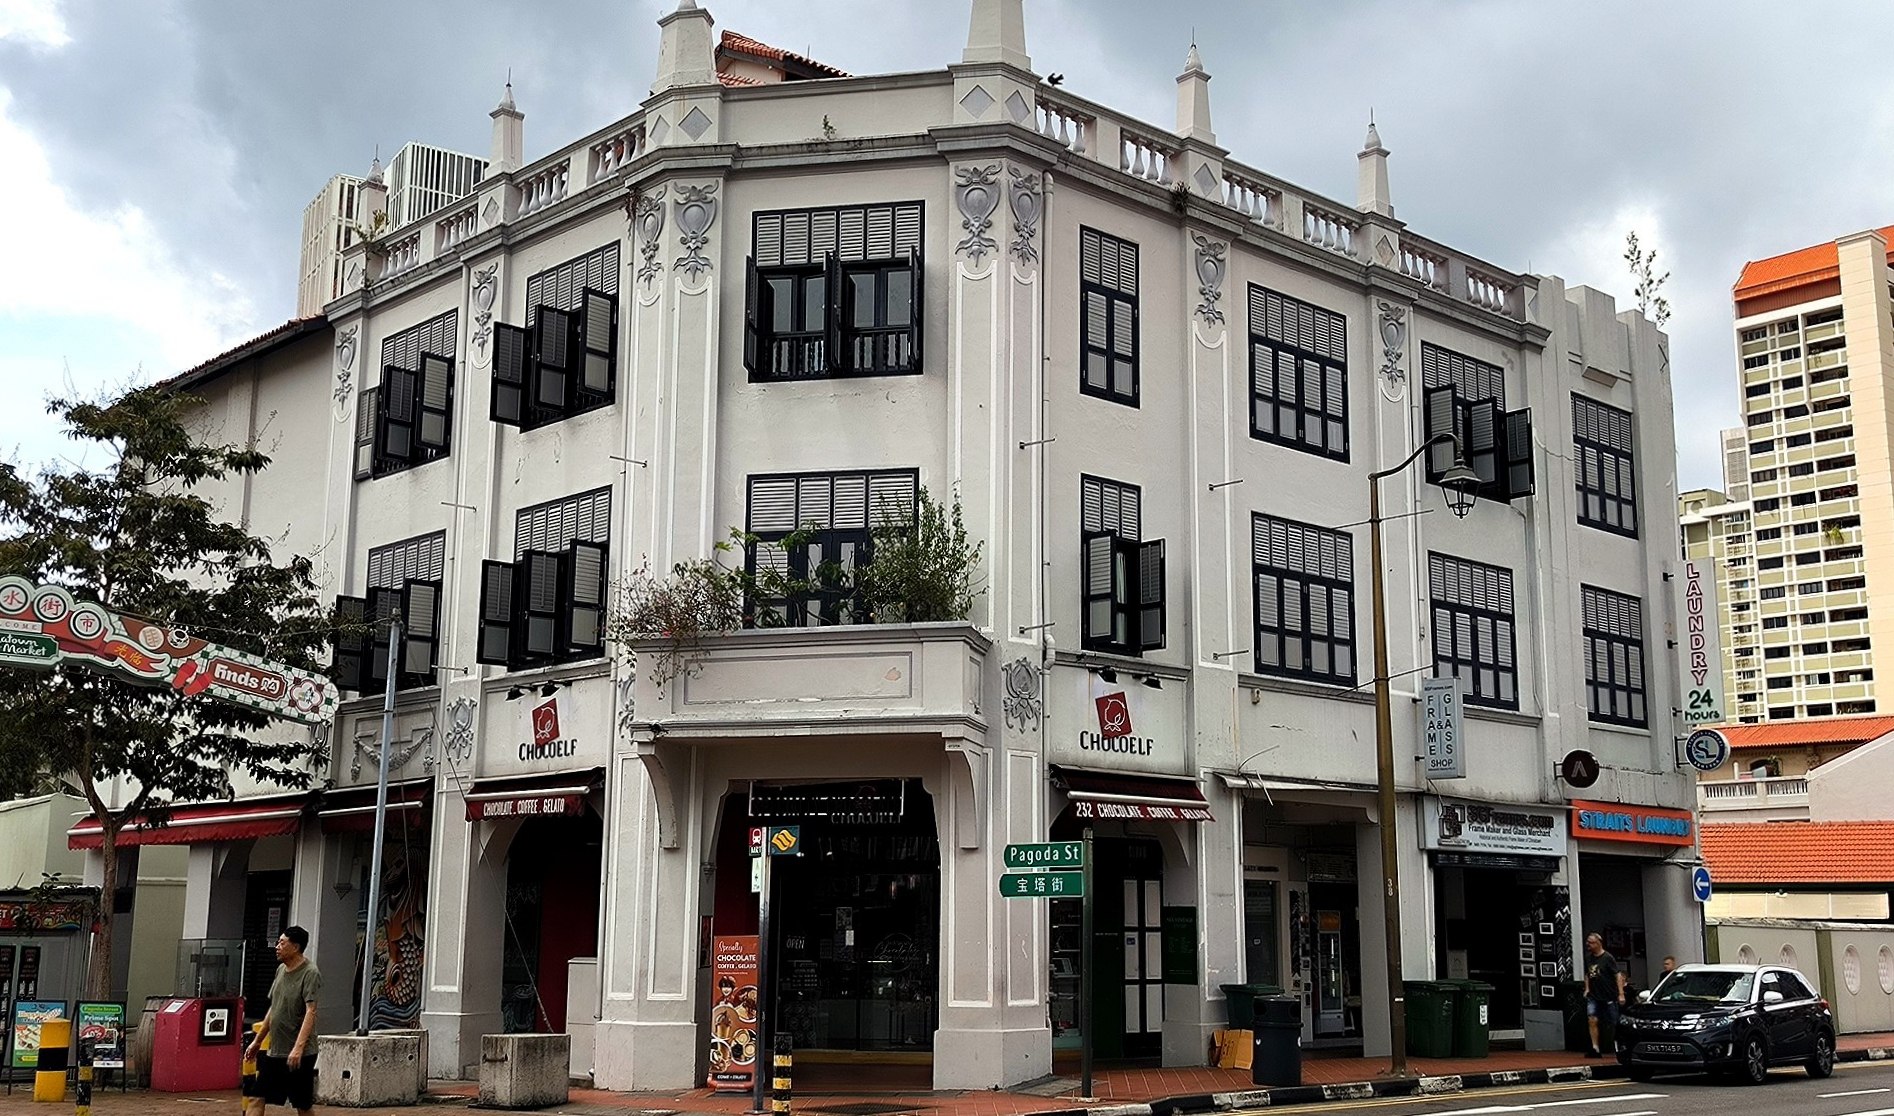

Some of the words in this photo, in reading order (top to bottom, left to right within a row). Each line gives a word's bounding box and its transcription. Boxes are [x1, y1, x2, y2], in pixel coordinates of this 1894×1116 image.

[0, 621, 38, 631] COME
[1686, 563, 1708, 686] LAUNDRY
[0, 634, 38, 647] atown
[3, 643, 47, 656] Market
[261, 677, 280, 694] 购
[1688, 689, 1714, 710] 24
[1684, 708, 1720, 722] hours
[1427, 695, 1437, 756] FRAME
[1436, 719, 1444, 730] &
[1443, 693, 1453, 755] GLASS
[518, 738, 578, 761] CHOCOELF
[1079, 730, 1154, 756] CHOCOELF
[1430, 759, 1453, 768] SHOP
[483, 801, 514, 816] CHOCOLATE
[517, 799, 538, 814] COFFEE
[543, 797, 565, 813] GELATO
[1076, 802, 1093, 817] 232
[1097, 803, 1144, 818] CHOCOLATE
[1468, 824, 1485, 833] Frame
[1502, 826, 1512, 835] and
[1512, 826, 1527, 836] Glass
[1578, 810, 1633, 832] STRAITS
[1636, 814, 1690, 837] LAUNDRY
[1010, 845, 1059, 865] Pagoda
[1064, 845, 1079, 860] St
[1017, 877, 1064, 893] 宝塔街
[717, 954, 756, 962] CHOCOLATE
